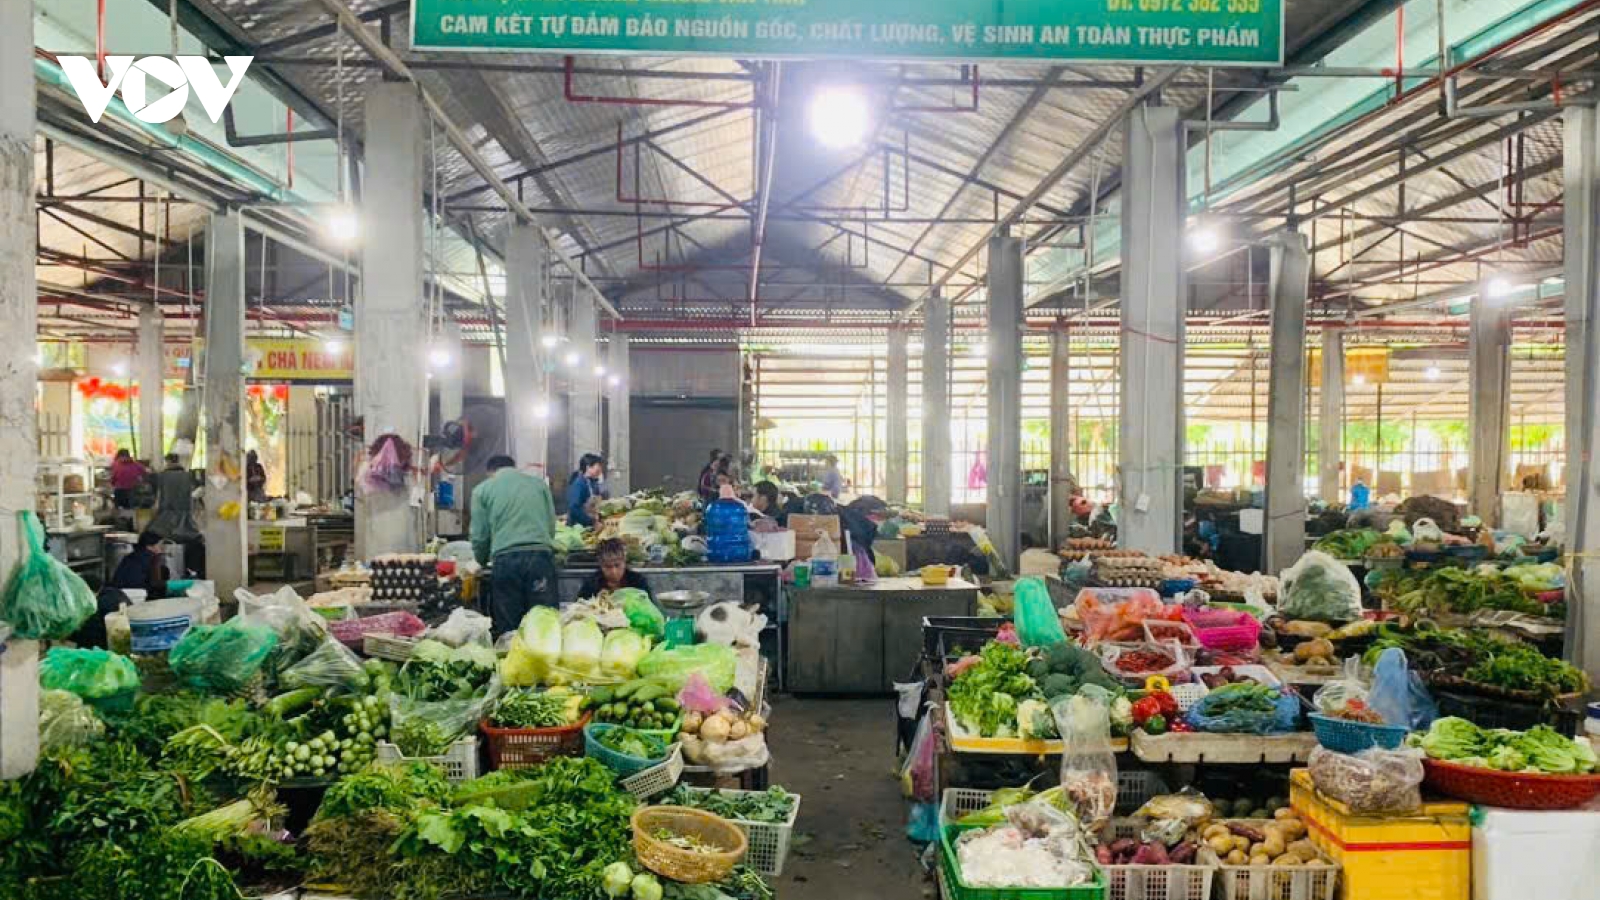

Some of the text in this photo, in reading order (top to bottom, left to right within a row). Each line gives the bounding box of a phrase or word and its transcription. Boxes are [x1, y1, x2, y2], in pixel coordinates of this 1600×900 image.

[440, 14, 488, 34] CAM
[494, 11, 533, 35] KẾT
[539, 14, 568, 38] TỰ
[571, 11, 619, 36] ĐẢM
[625, 12, 668, 37] BẢO
[673, 13, 749, 39] NGUỒN
[810, 15, 863, 42] CHẤT
[952, 22, 977, 46] VỆ
[983, 24, 1034, 44] SINH
[1039, 24, 1070, 45] AN
[1076, 23, 1131, 45] TOÀN
[1137, 25, 1192, 49] THỰC
[1197, 20, 1260, 47] PHẨM
